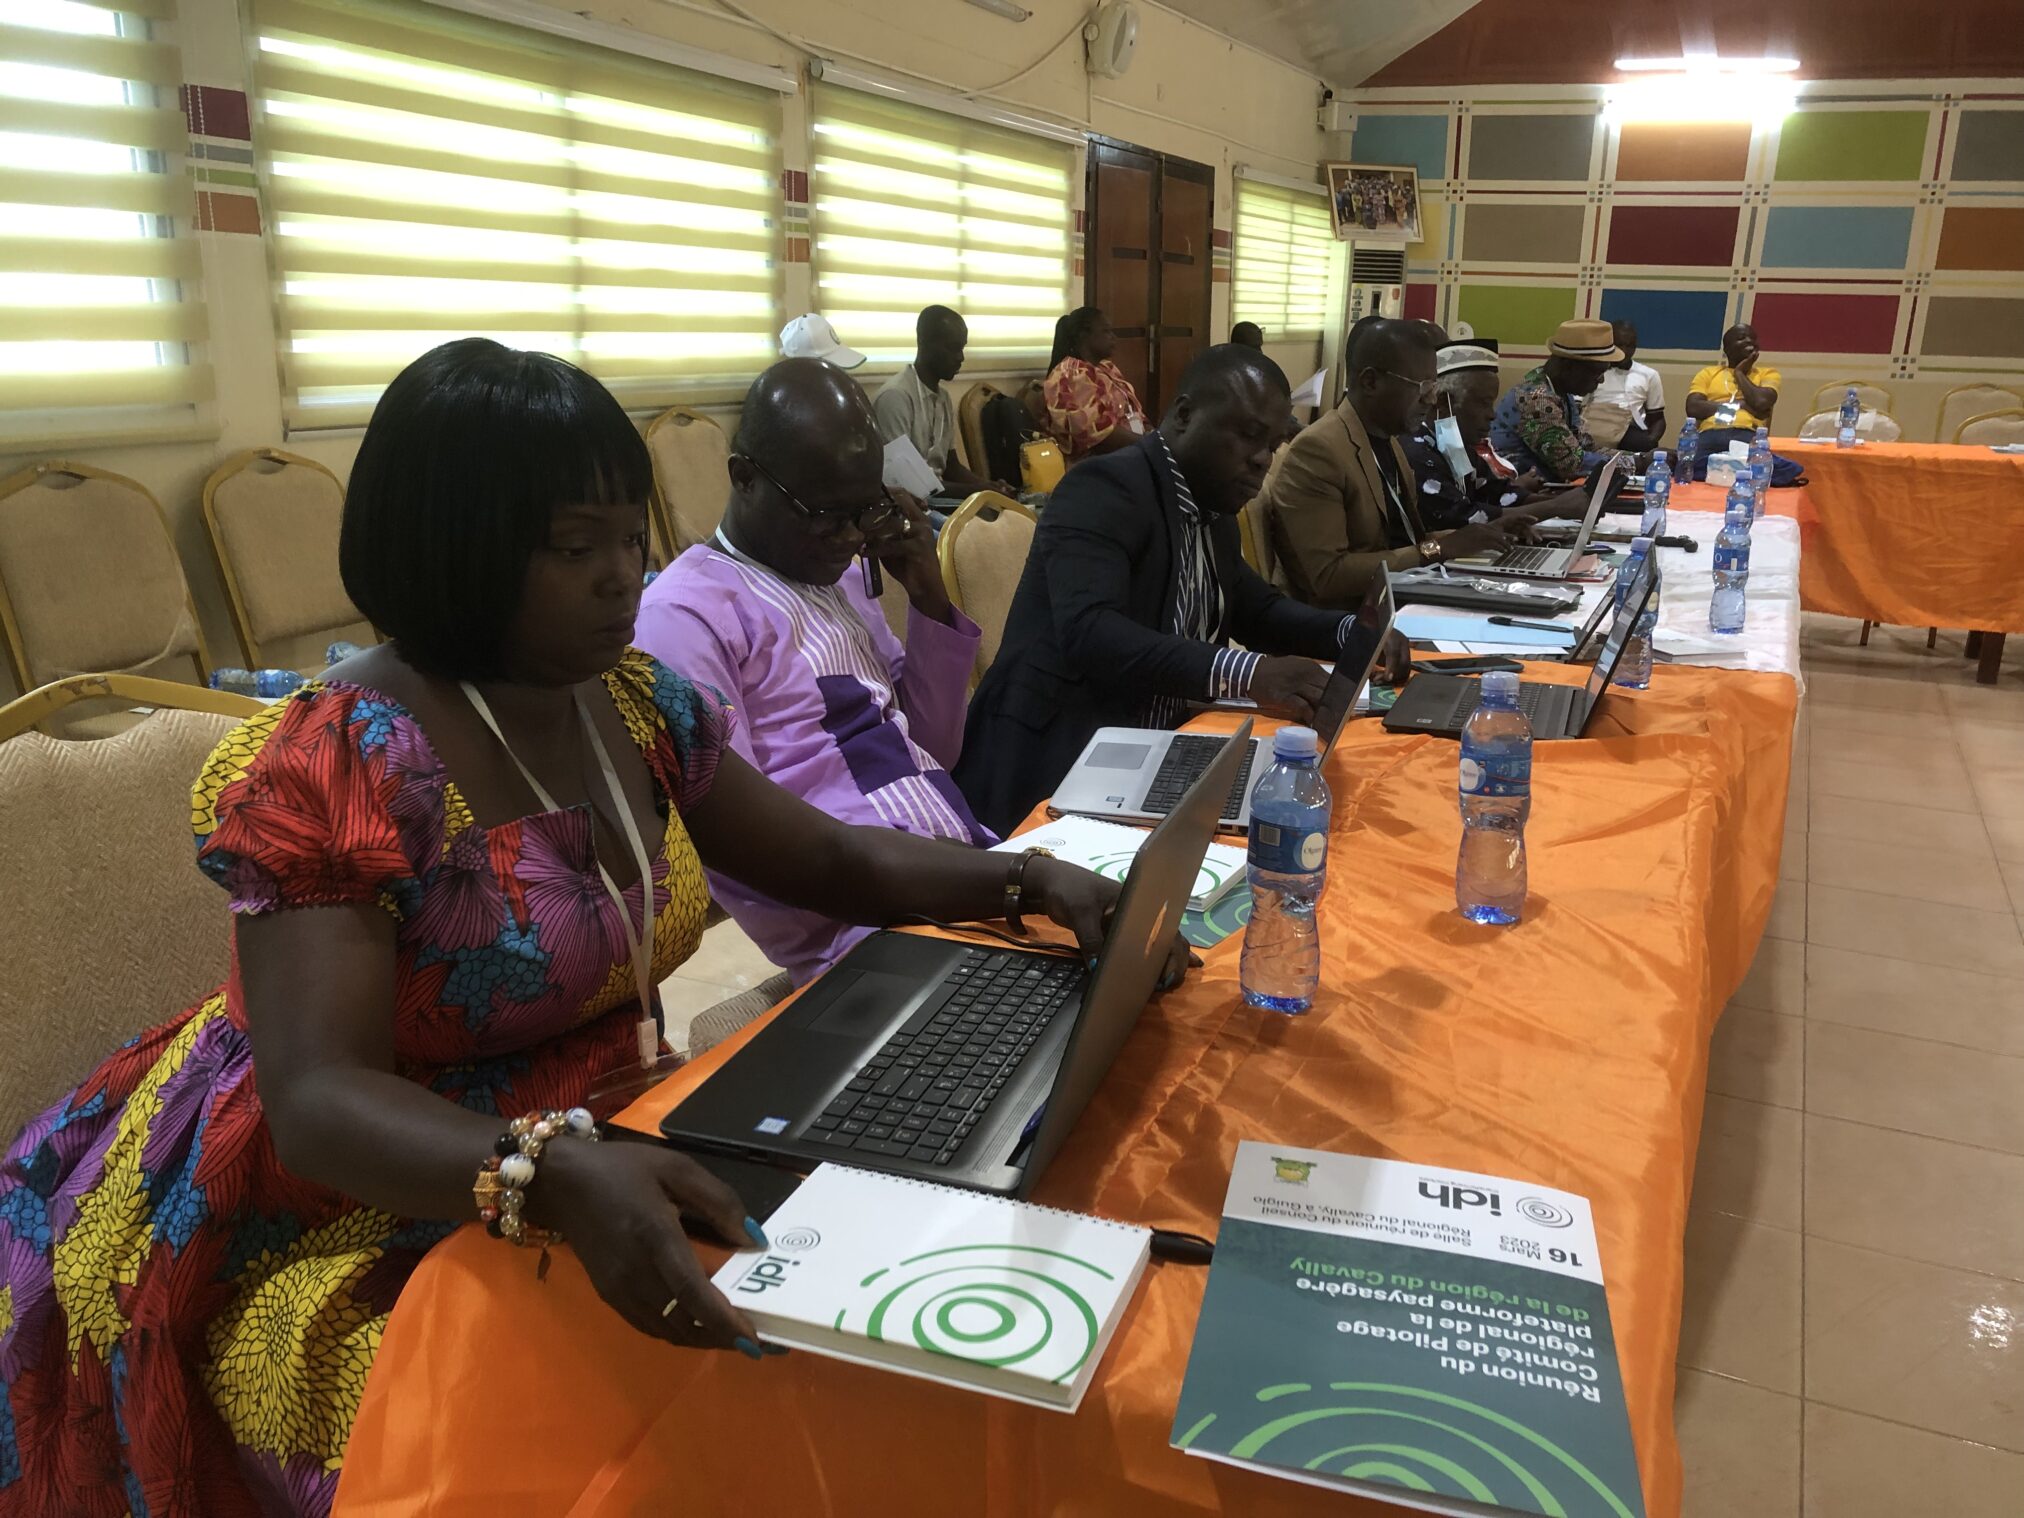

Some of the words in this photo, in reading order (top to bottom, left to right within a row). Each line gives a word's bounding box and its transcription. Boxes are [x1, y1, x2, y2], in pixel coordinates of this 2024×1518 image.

[1251, 1195, 1301, 1211] Guiglo
[1417, 1180, 1501, 1216] idh
[1260, 1205, 1317, 1221] Conseil
[1320, 1214, 1340, 1226] du
[1378, 1214, 1398, 1225] du
[1408, 1227, 1428, 1239] de
[1432, 1232, 1471, 1246] Salle
[1498, 1234, 1540, 1250] 2023
[1497, 1242, 1540, 1260] Mars
[1547, 1247, 1582, 1266] 16
[737, 1254, 801, 1294] idh
[1287, 1255, 1383, 1284] Cavally
[1389, 1273, 1423, 1290] du
[1294, 1276, 1433, 1308] paysagère
[1429, 1279, 1518, 1307] région
[1524, 1296, 1549, 1314] la
[1554, 1302, 1588, 1322] de
[1408, 1311, 1431, 1330] la
[1438, 1316, 1471, 1335] de
[1439, 1298, 1591, 1338] plateforme
[1335, 1318, 1447, 1351] Pilotage
[1477, 1323, 1594, 1360] régional
[1454, 1338, 1488, 1357] de
[1439, 1355, 1474, 1374] du
[1494, 1345, 1597, 1381] Comité
[1481, 1362, 1600, 1402] Réunion
